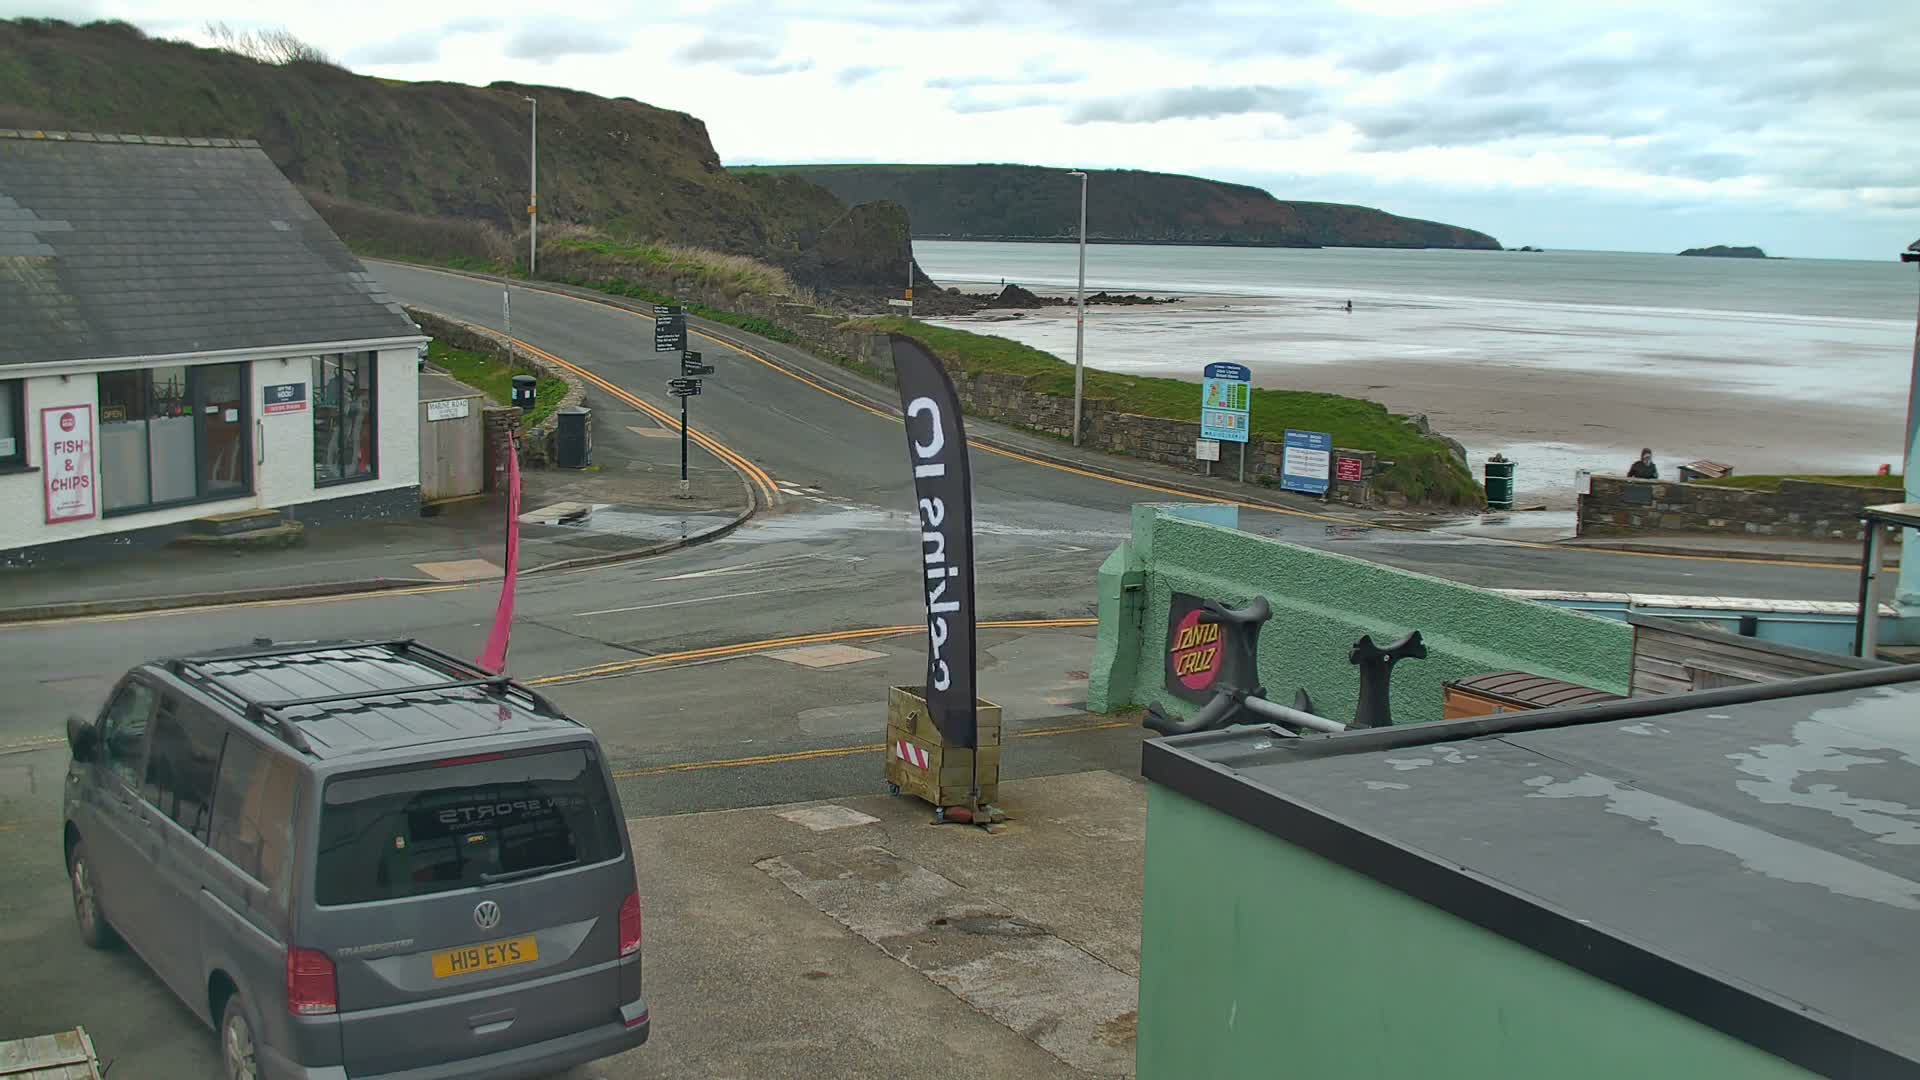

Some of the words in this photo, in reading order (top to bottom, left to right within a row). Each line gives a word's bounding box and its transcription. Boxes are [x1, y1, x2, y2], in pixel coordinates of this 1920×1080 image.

[452, 400, 467, 408] ROAD
[54, 440, 84, 455] FISH
[64, 459, 74, 471] &
[51, 475, 90, 492] CHIPS
[1170, 623, 1219, 652] SANTA
[1176, 647, 1217, 676] CRUZ
[450, 949, 481, 972] H19
[484, 941, 520, 965] EYS
